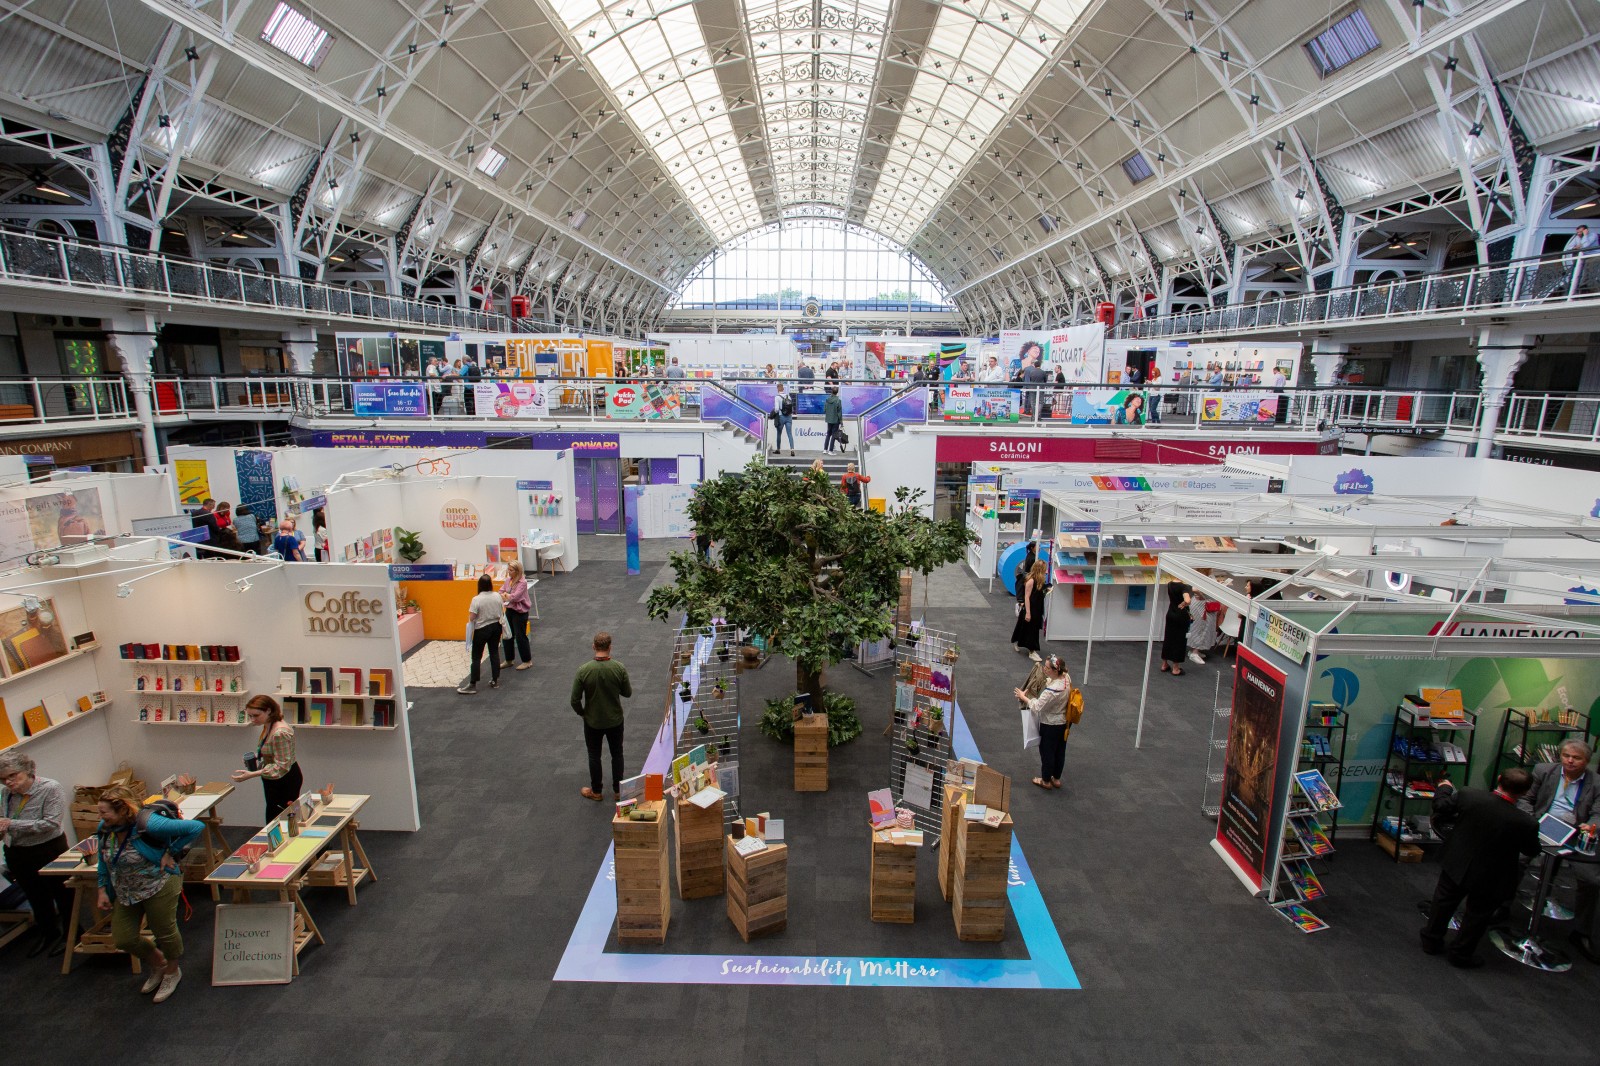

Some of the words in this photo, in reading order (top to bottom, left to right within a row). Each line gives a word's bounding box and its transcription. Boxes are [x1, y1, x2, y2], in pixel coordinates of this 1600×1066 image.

[1052, 334, 1068, 344] ZEBRA
[508, 342, 516, 367] HINK
[387, 388, 400, 397] Save
[400, 388, 408, 397] the
[408, 388, 421, 397] date
[374, 435, 410, 444] EVENT
[571, 441, 618, 450] ONWARD
[20, 441, 73, 454] COMPANY
[990, 441, 1042, 453] SALONI
[1208, 445, 1261, 456] SALONI
[1074, 479, 1093, 487] love
[1097, 479, 1148, 488] colour
[1152, 480, 1170, 488] love
[36, 501, 51, 512] gift
[446, 514, 471, 522] upon
[441, 519, 478, 531] tuesday
[304, 590, 383, 615] Coffee
[1264, 623, 1284, 638] RECYCLED
[1284, 633, 1299, 647] RANGE
[1255, 626, 1266, 640] THE
[1266, 633, 1278, 647] REAL
[1277, 642, 1304, 661] SOLUTION
[930, 683, 949, 695] frisk
[1246, 672, 1276, 698] HAINENKO
[224, 928, 271, 939] Discover
[223, 939, 241, 950] the
[223, 950, 282, 962] Collections
[720, 959, 852, 986] Sustainability
[860, 960, 939, 979] Matters
